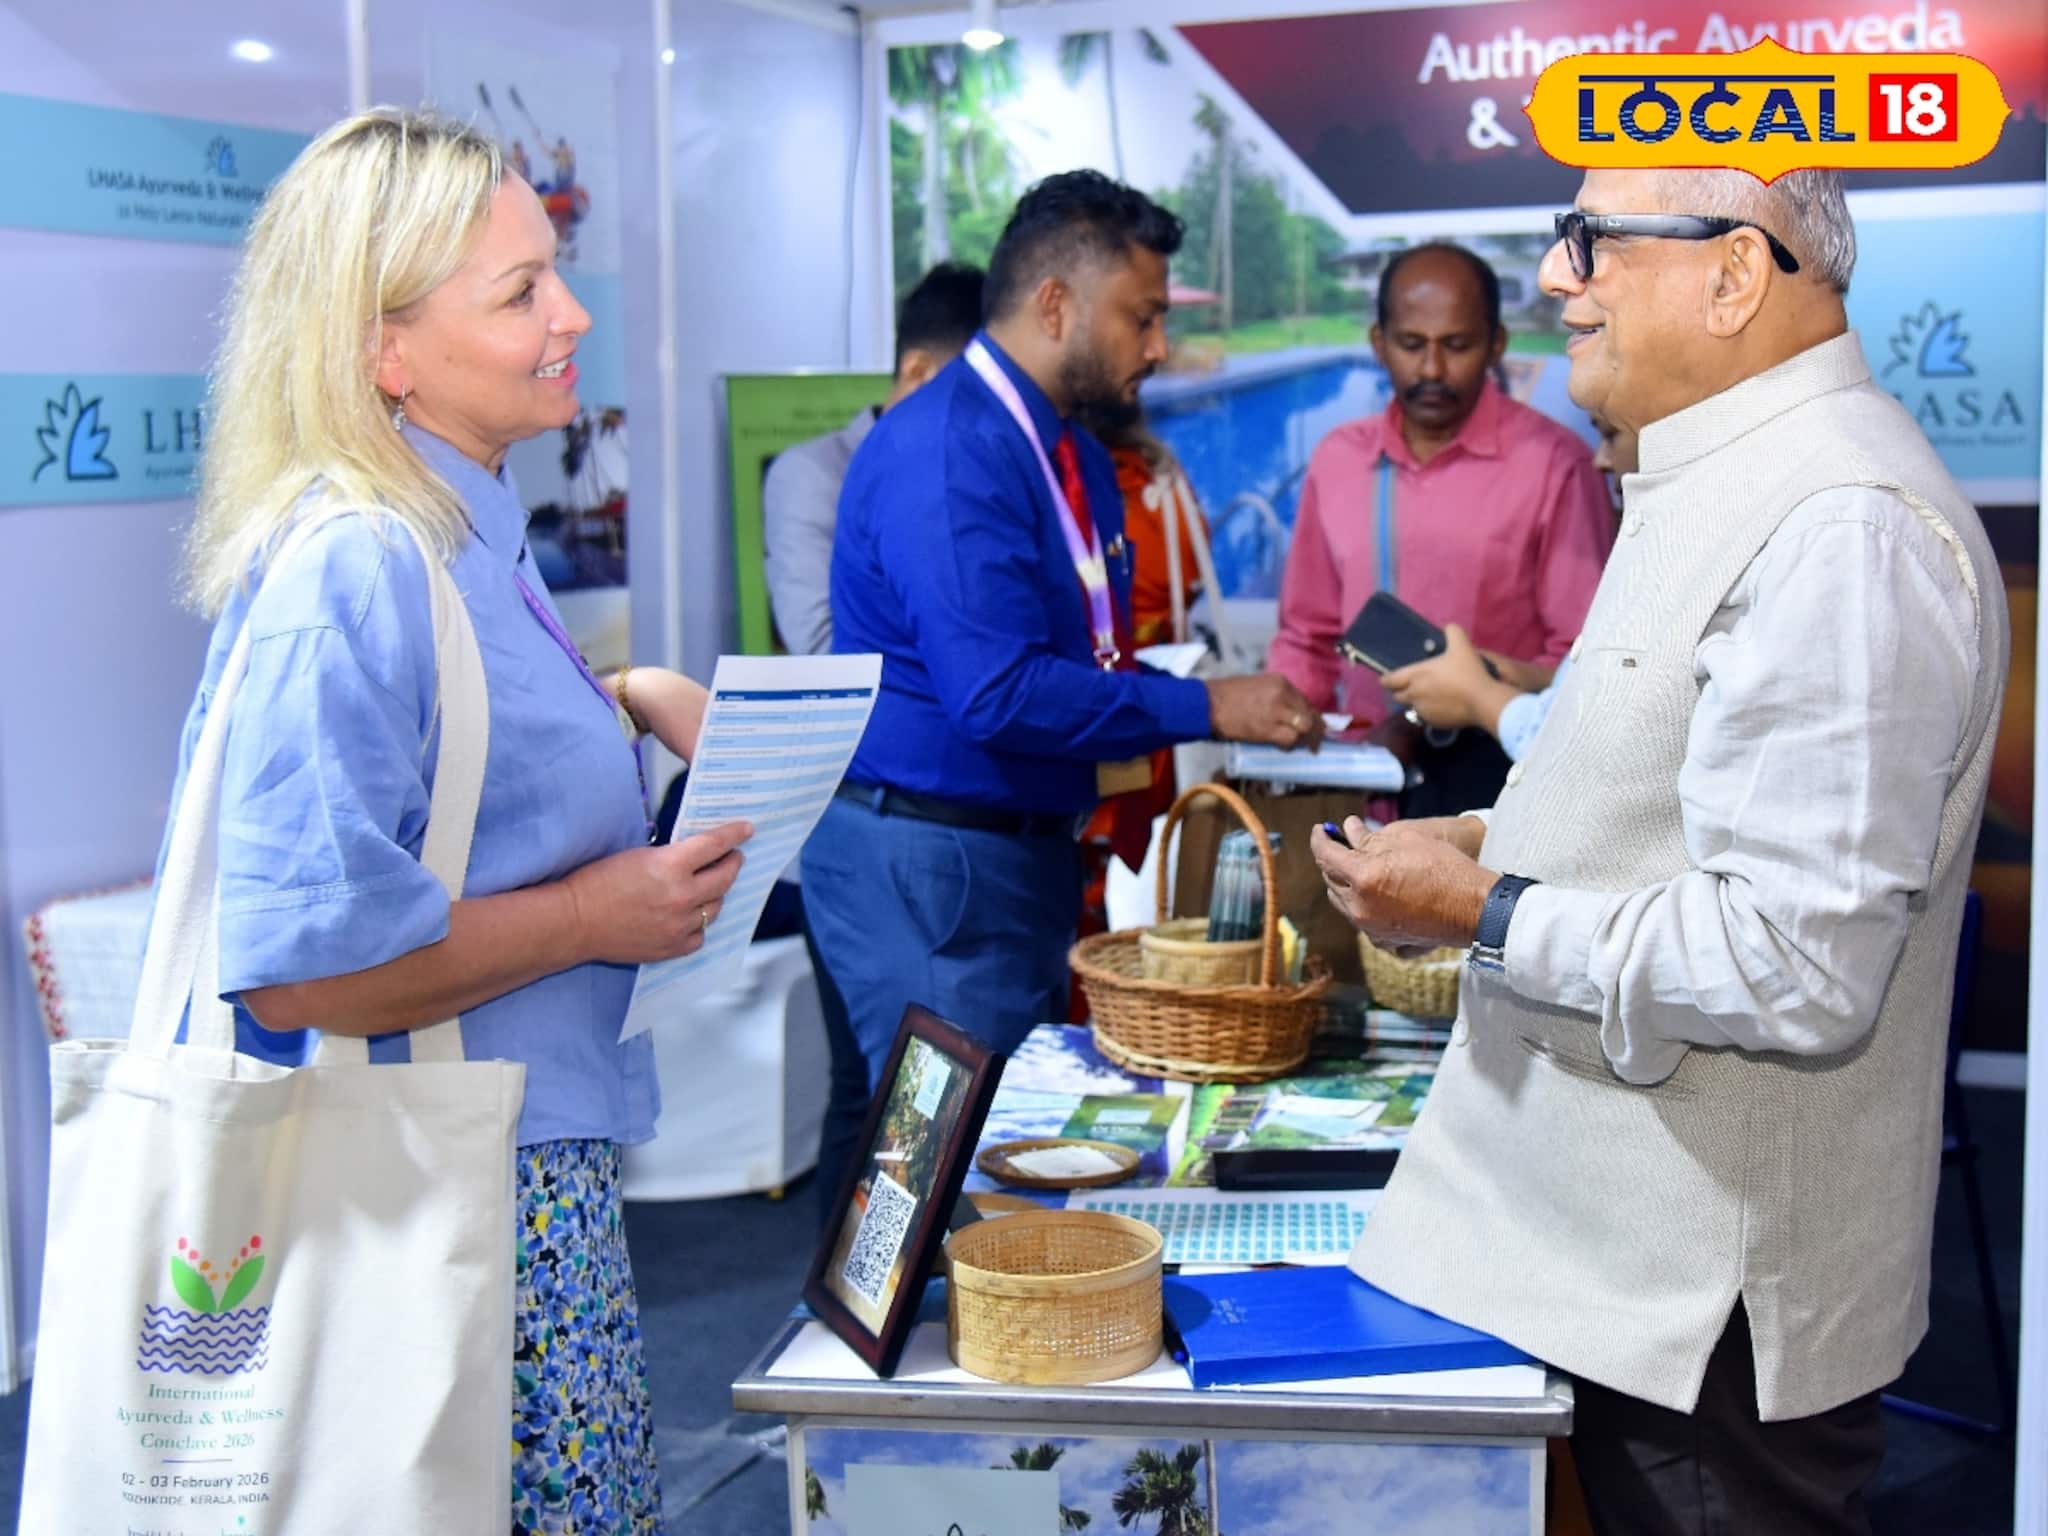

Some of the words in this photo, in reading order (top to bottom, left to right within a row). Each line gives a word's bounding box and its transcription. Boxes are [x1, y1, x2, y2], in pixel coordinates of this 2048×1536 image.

[1466, 96, 1518, 150] &
[149, 1383, 256, 1401] International
[115, 1406, 193, 1426] Ayurveda
[199, 1410, 214, 1425] &
[221, 1407, 286, 1424] Wellness
[140, 1432, 218, 1449] Conclave
[223, 1432, 255, 1448] 2026
[150, 1475, 168, 1488] 03
[173, 1475, 233, 1489] February
[237, 1472, 269, 1486] 2026
[238, 1491, 270, 1504] INDIA
